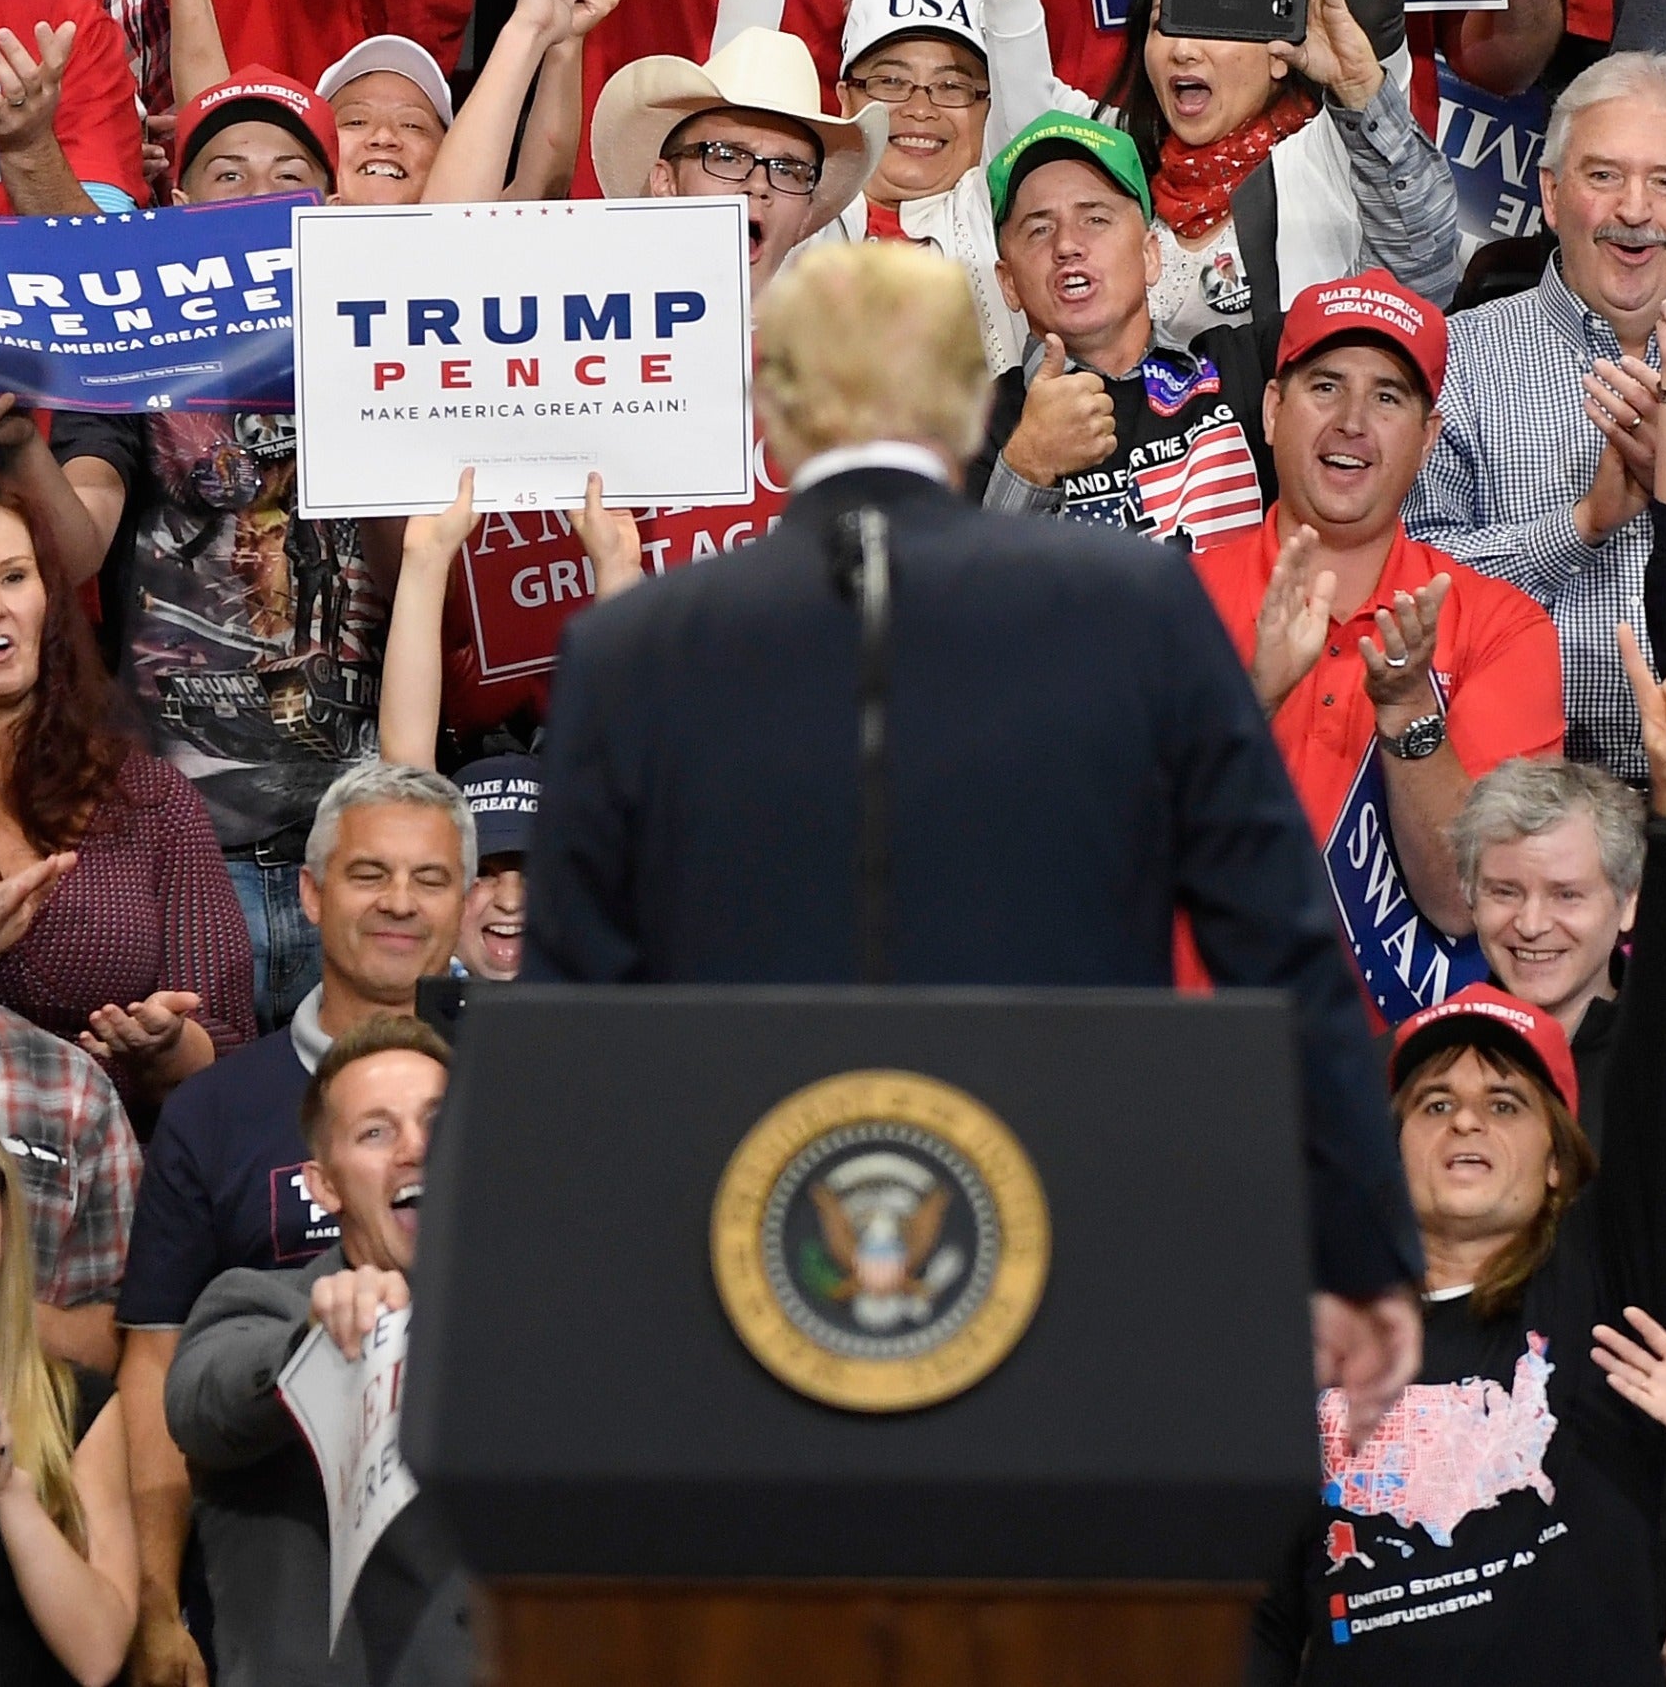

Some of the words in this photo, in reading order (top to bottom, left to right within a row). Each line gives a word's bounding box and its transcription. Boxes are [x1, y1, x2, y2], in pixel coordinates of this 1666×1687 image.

[200, 88, 238, 110] MAKE
[239, 84, 310, 110] AMERICA
[337, 291, 708, 348] TRUMP
[1317, 288, 1362, 305] MAKE
[1363, 288, 1424, 327] AMERICA
[1324, 301, 1372, 317] GREAT
[1373, 305, 1417, 336] AGAIN
[48, 337, 144, 355] AMERICA
[148, 326, 219, 348] GREAT
[225, 314, 293, 335] AGAIN
[374, 354, 674, 391] PENCE
[146, 394, 171, 409] 45
[361, 406, 422, 422] MAKE
[428, 403, 527, 419] AMERICA
[534, 402, 605, 417] GREAT
[612, 398, 688, 414] AGAIN!
[1063, 474, 1112, 498] AND
[1149, 437, 1185, 460] THE
[1184, 404, 1234, 444] FLAG
[514, 491, 538, 506] 45
[174, 676, 261, 697] TRUMP
[462, 781, 502, 798] MAKE
[470, 798, 518, 814] GREAT
[1463, 1002, 1535, 1030] AMERICA
[306, 1226, 341, 1240] MAKE
[1347, 1584, 1406, 1610] UNITED
[1410, 1569, 1480, 1596] STATES
[1483, 1558, 1509, 1578] OF
